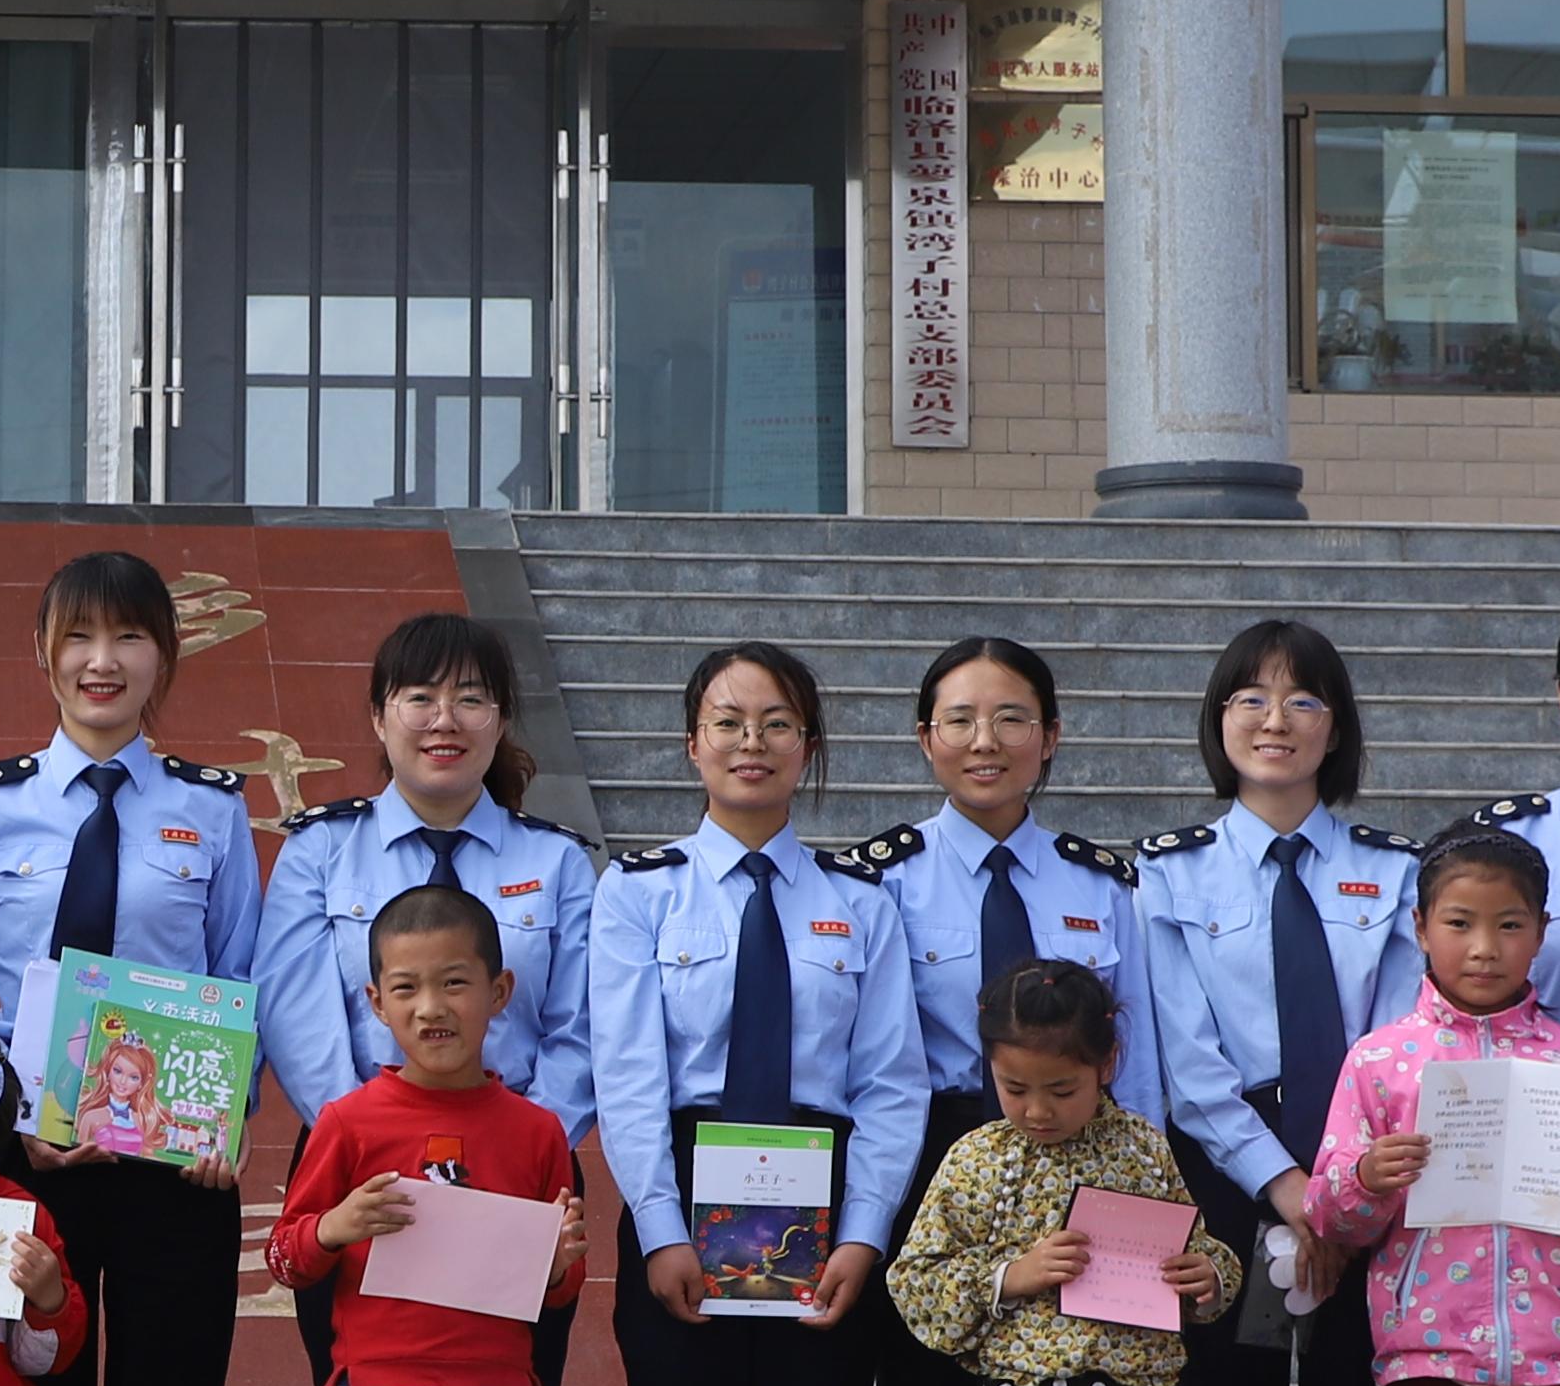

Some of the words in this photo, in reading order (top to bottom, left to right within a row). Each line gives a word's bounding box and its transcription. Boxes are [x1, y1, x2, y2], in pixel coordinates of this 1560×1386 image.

[163, 1044, 226, 1081] 闪亮
[157, 1073, 235, 1110] 小公主
[744, 1173, 782, 1186] 小王子
